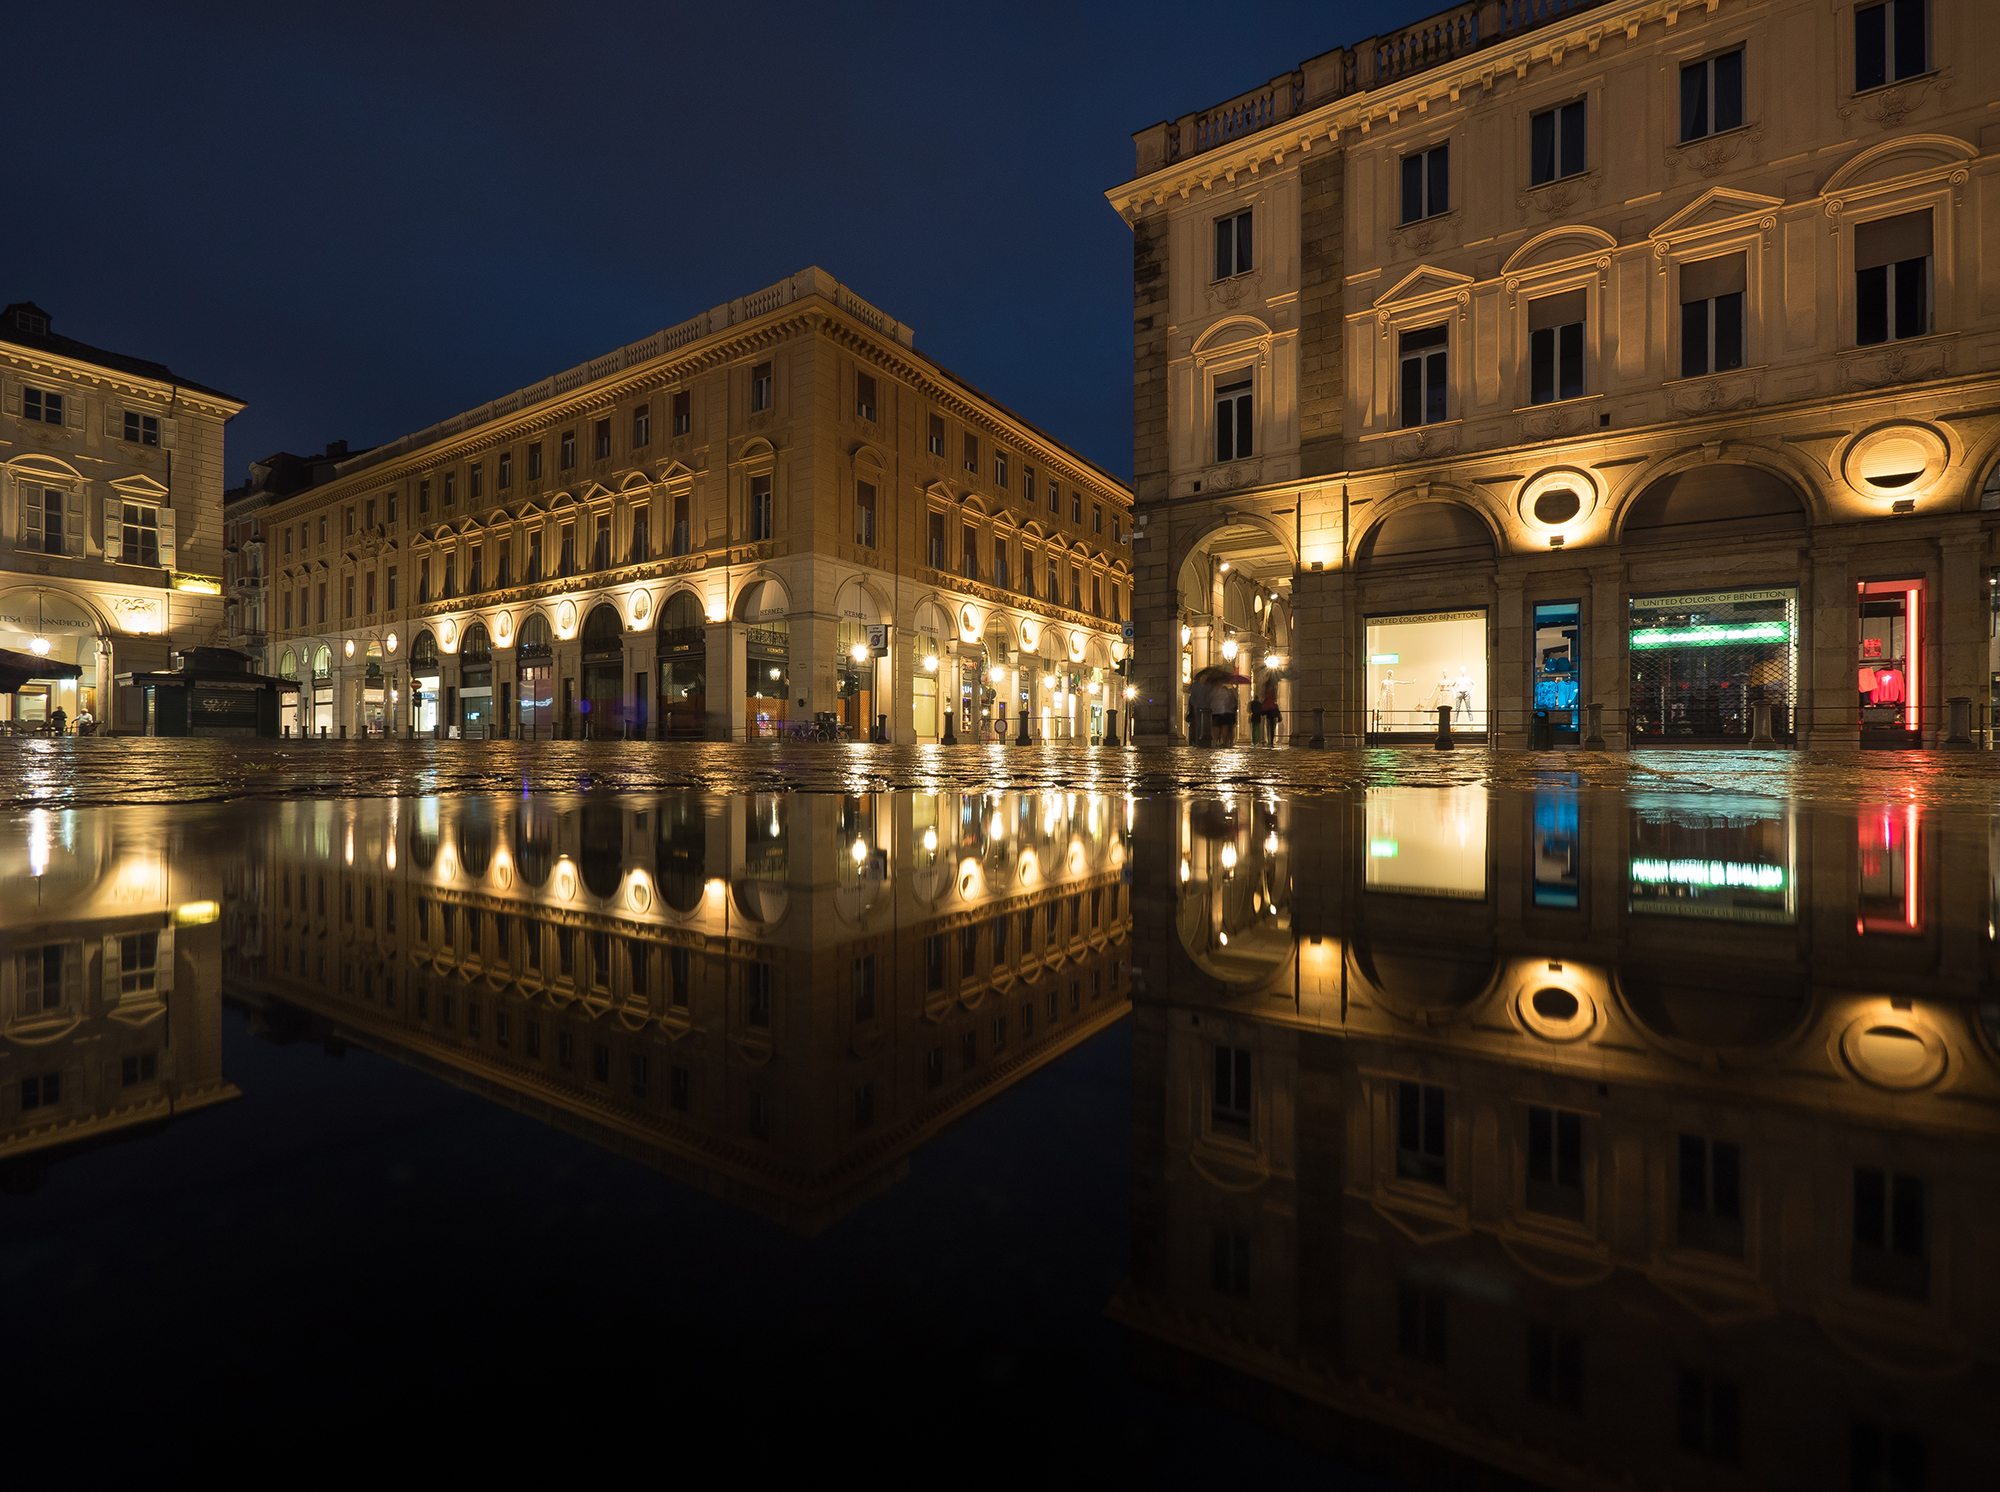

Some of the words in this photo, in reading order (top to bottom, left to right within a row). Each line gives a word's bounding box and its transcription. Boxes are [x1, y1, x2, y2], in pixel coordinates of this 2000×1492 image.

[1642, 599, 1678, 607] UNITED
[1678, 596, 1717, 605] COLORS
[1718, 594, 1732, 602] OF
[40, 618, 91, 628] SANPAOLO
[1371, 617, 1398, 625] UNITED
[1399, 615, 1427, 624] COLORS
